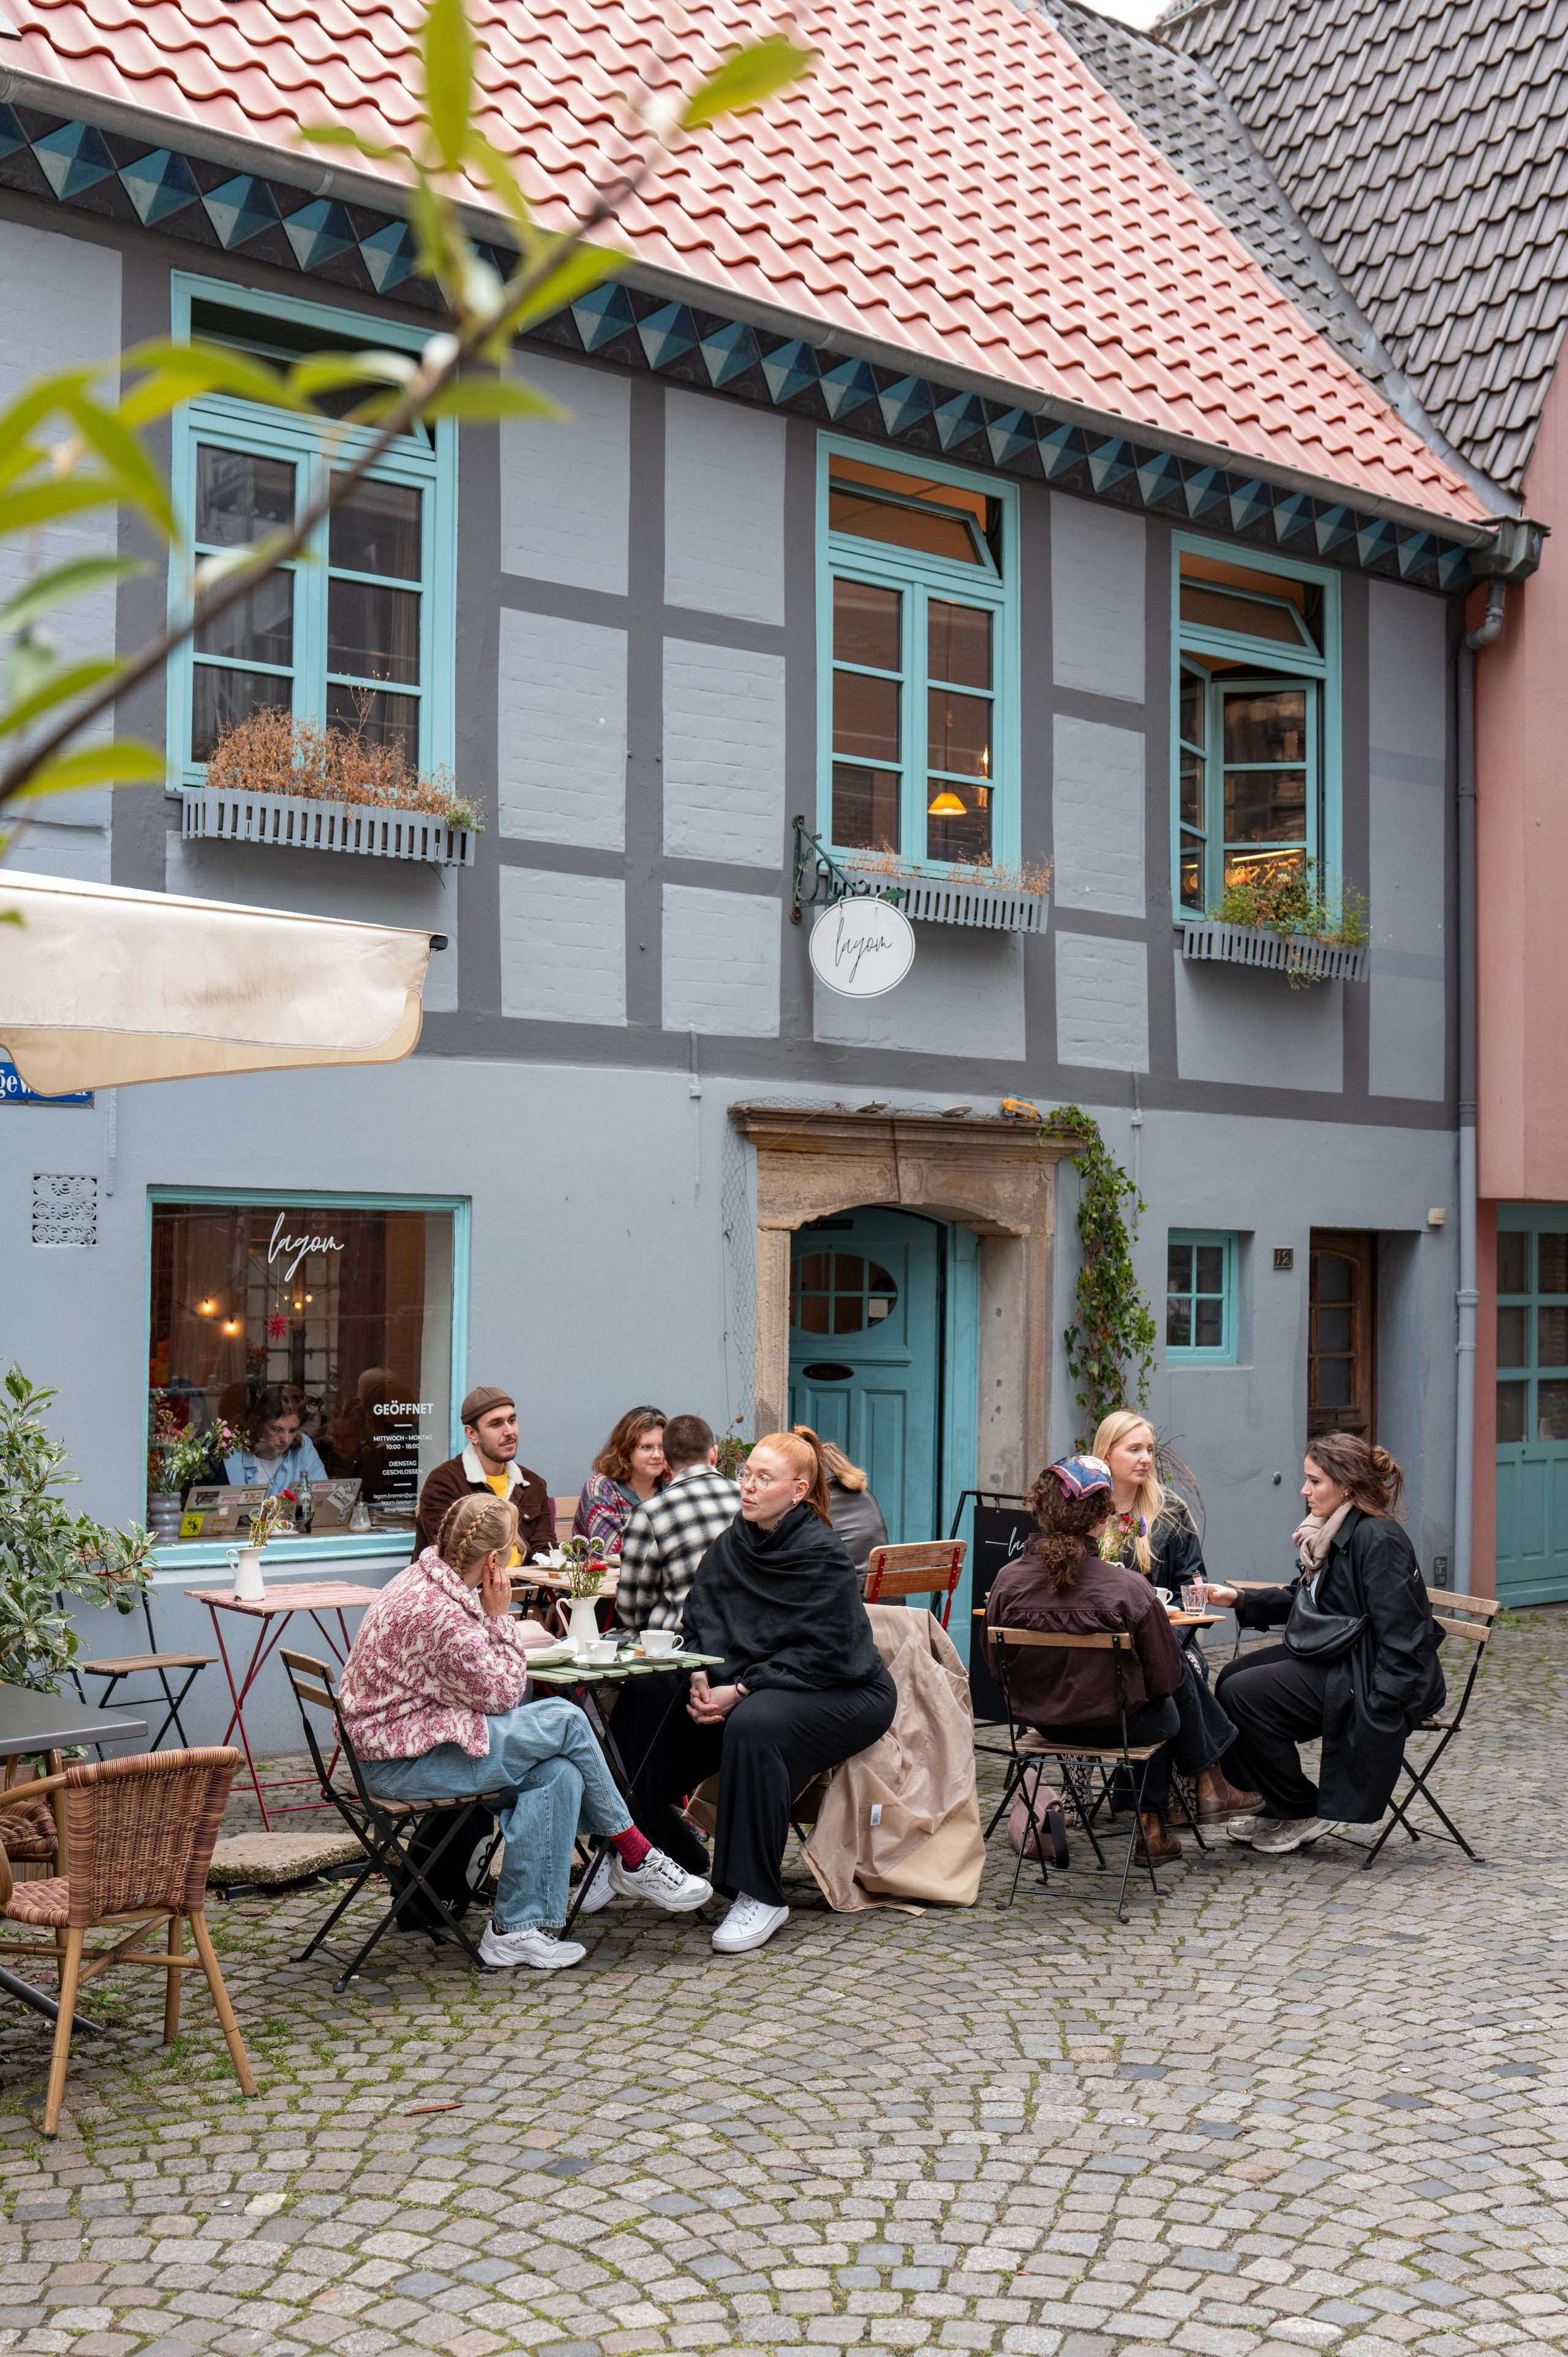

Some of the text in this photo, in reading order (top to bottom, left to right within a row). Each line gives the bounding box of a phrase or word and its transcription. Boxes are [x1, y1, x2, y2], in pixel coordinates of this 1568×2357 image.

[835, 917, 892, 983] lagom
[268, 1211, 345, 1282] lagom
[1276, 1250, 1290, 1265] 12
[373, 1399, 434, 1415] GEÖFFNET
